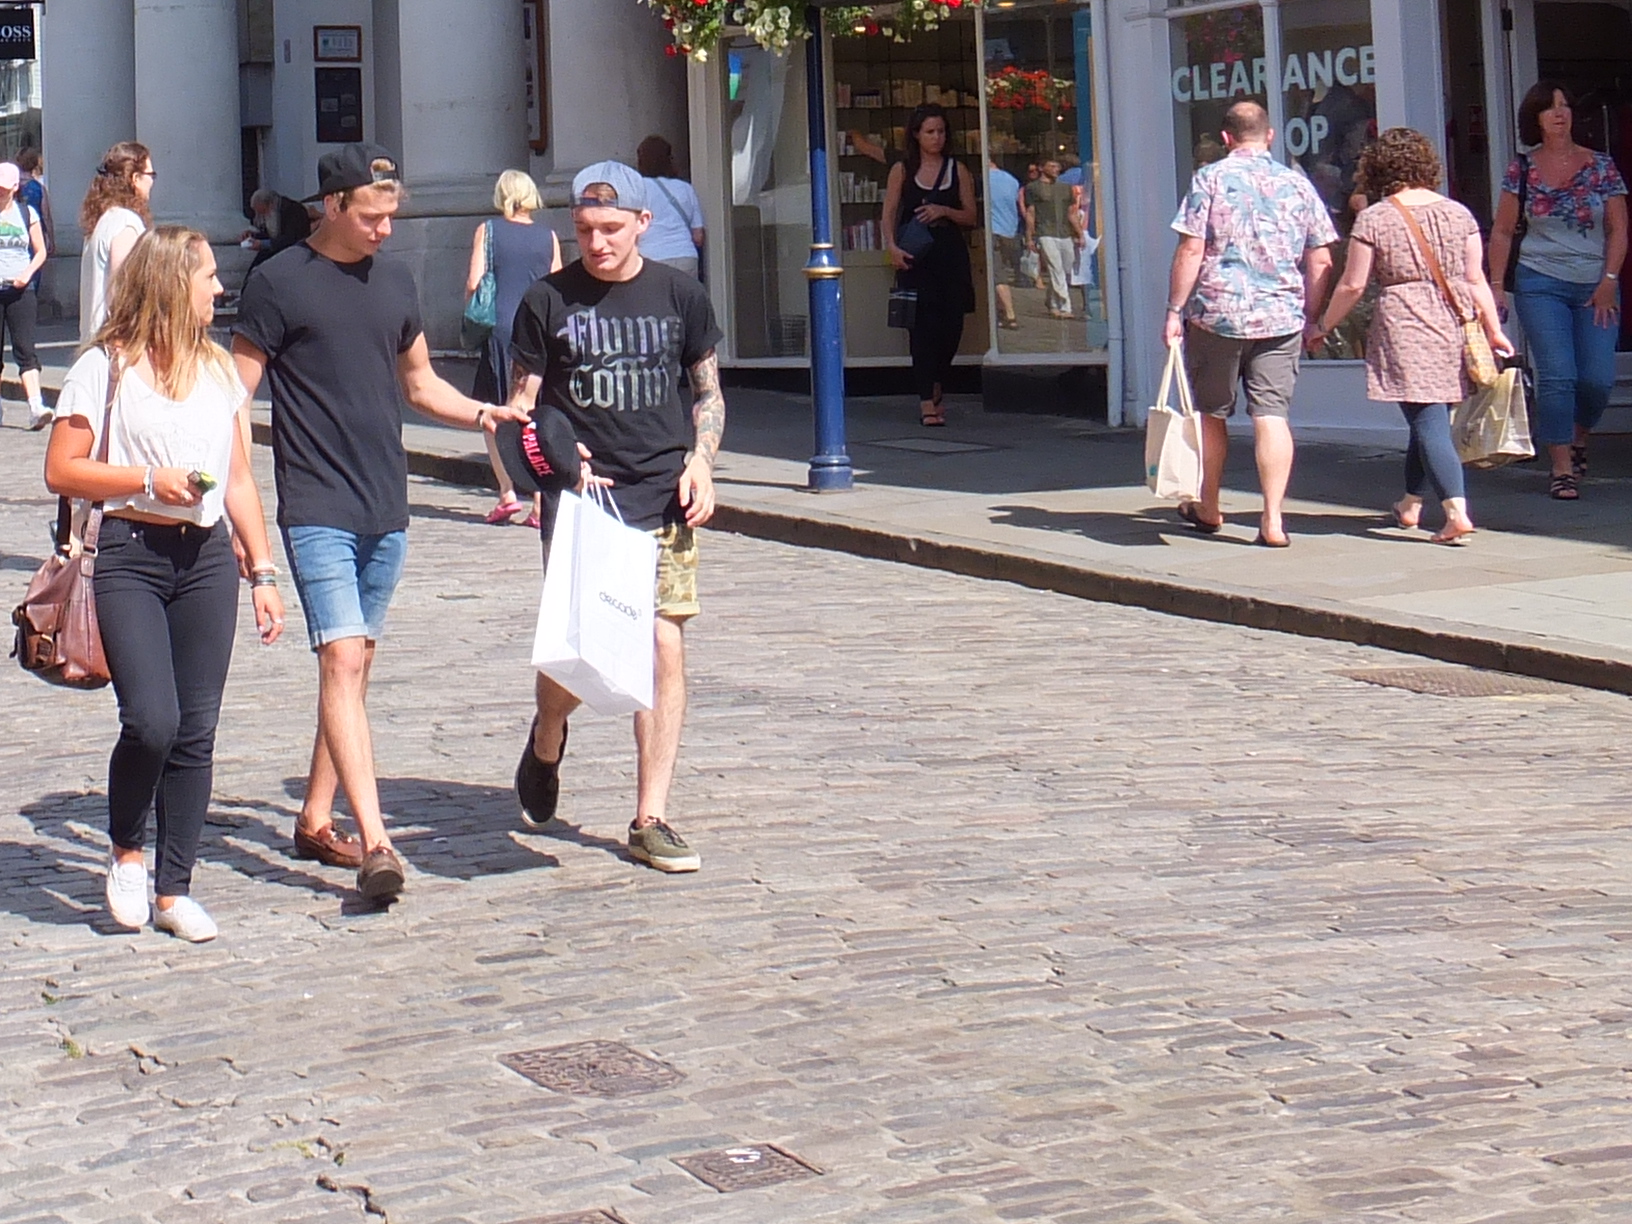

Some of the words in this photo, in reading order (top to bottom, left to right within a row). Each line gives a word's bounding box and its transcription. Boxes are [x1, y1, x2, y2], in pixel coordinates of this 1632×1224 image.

[1172, 45, 1376, 103] CLEARANCE
[1285, 115, 1329, 156] OP
[522, 433, 555, 477] PALACE
